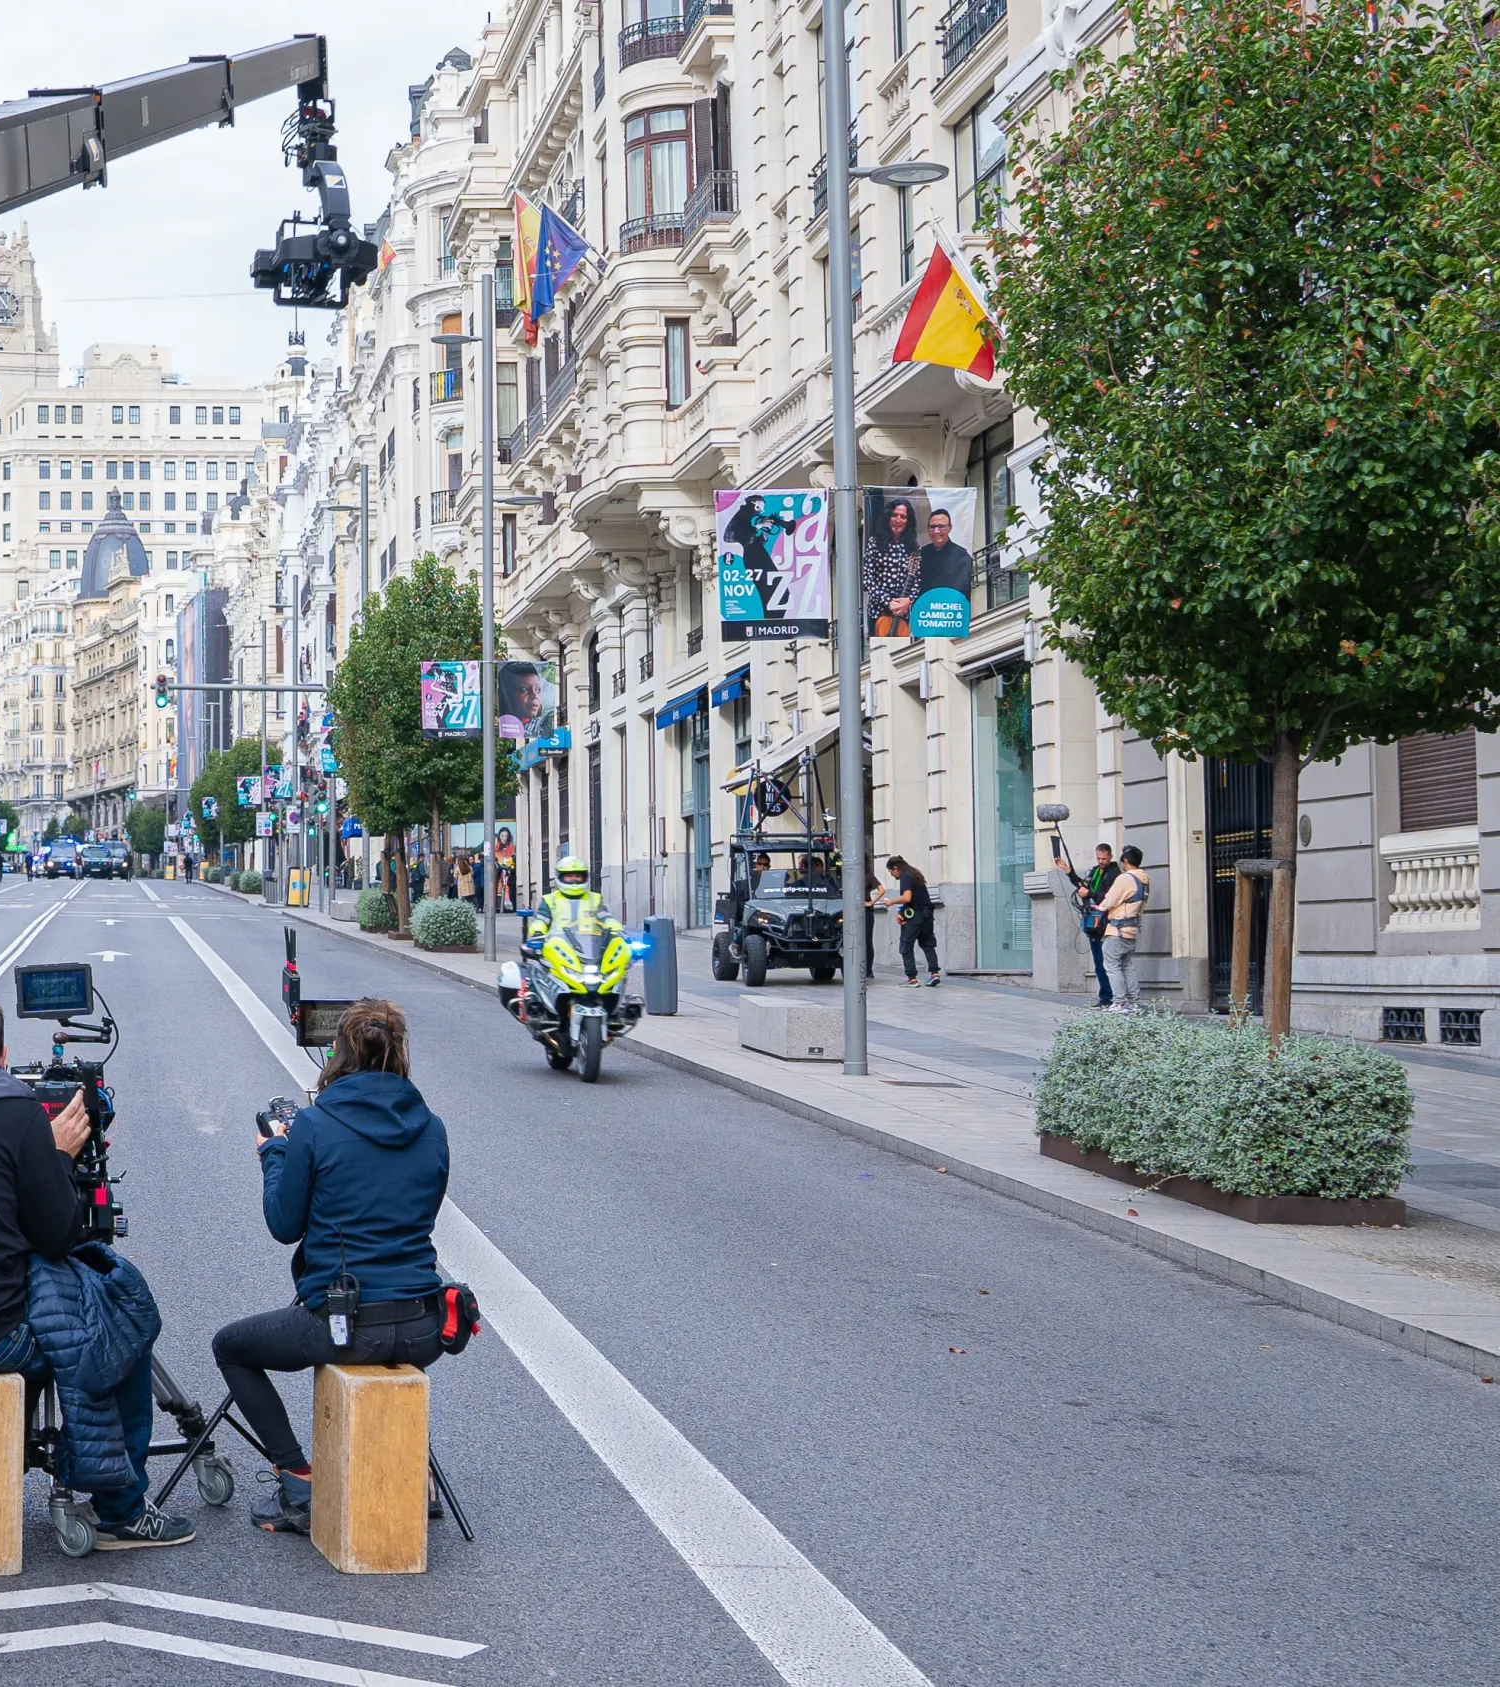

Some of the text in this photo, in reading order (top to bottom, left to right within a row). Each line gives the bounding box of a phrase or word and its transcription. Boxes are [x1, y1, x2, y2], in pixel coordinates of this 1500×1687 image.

[723, 569, 763, 582] 02-27
[724, 584, 756, 597] NOV
[930, 602, 963, 610] MICHEL
[919, 611, 954, 619] CAMILO
[917, 620, 963, 628] TOMATITO
[758, 625, 800, 636] MADRID
[425, 702, 447, 710] 02-27
[138, 1513, 164, 1540] N
